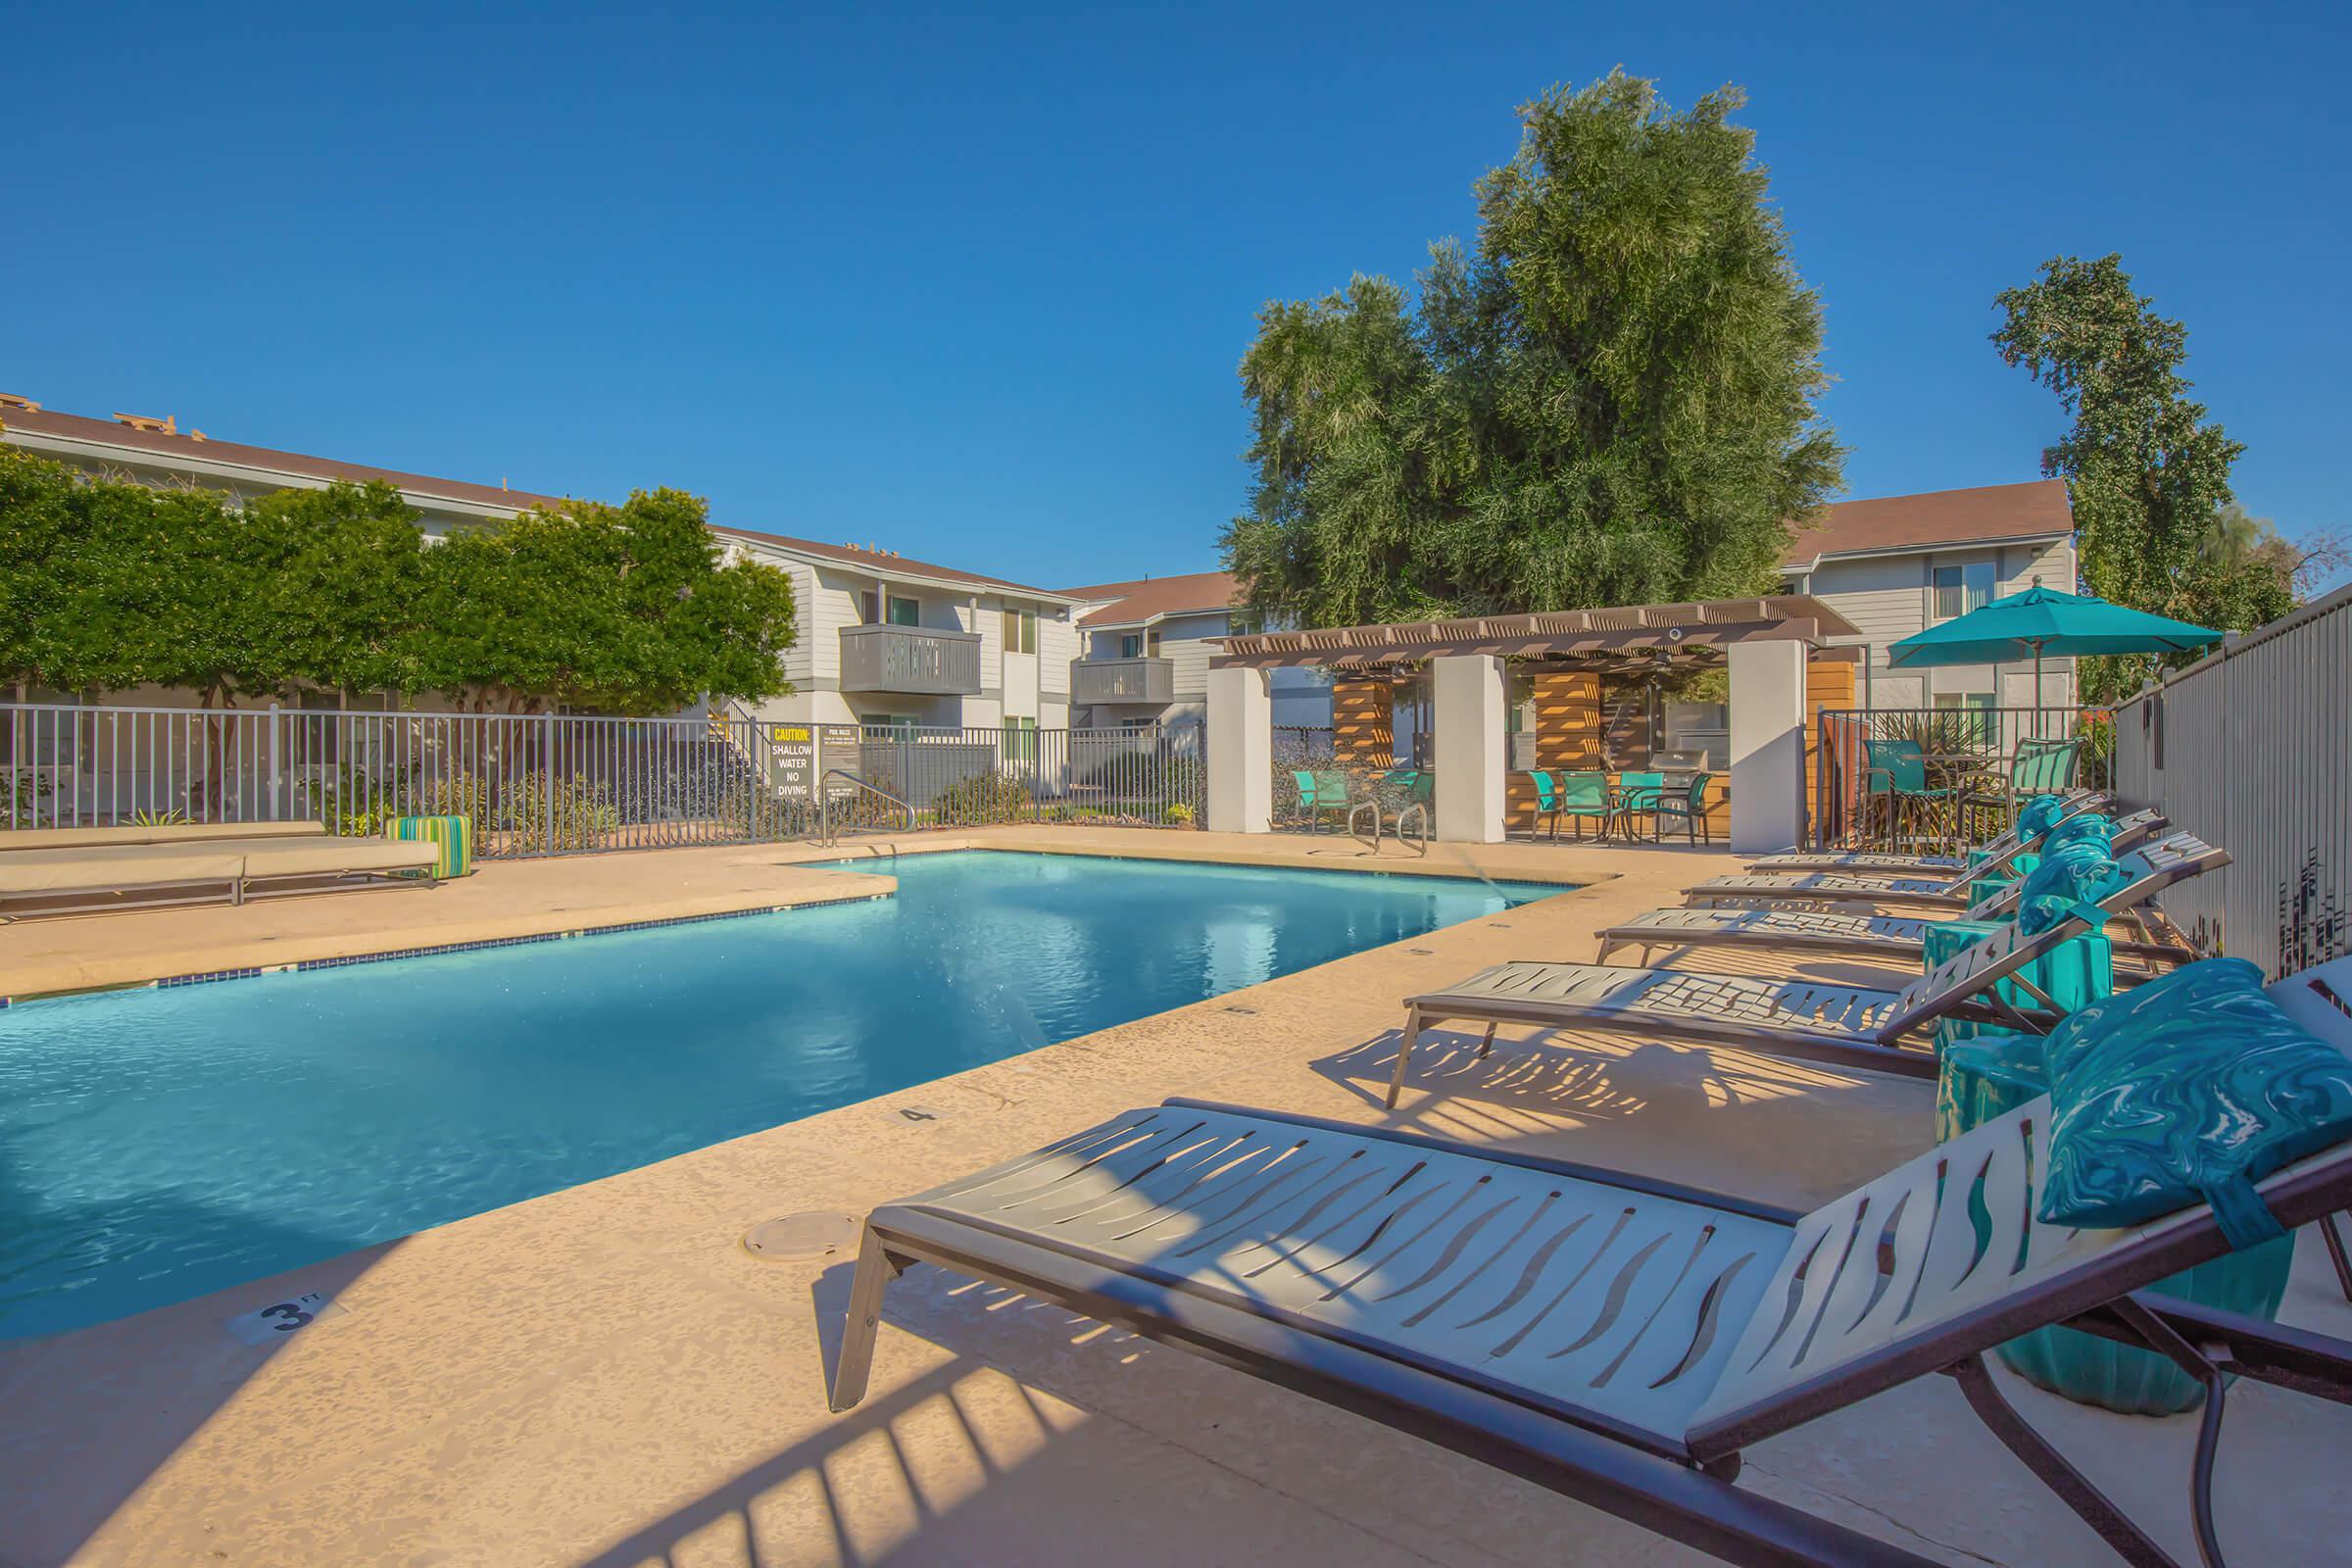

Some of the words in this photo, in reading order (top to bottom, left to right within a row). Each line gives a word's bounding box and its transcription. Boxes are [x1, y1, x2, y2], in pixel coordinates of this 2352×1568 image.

[775, 728, 810, 741] CAUTION:
[772, 745, 812, 755] SHALLOW
[779, 760, 807, 768] WATER
[787, 772, 800, 781] NO
[778, 785, 807, 795] DIVING
[900, 1109, 937, 1121] 4
[261, 1303, 314, 1331] 3
[301, 1294, 320, 1303] FT
